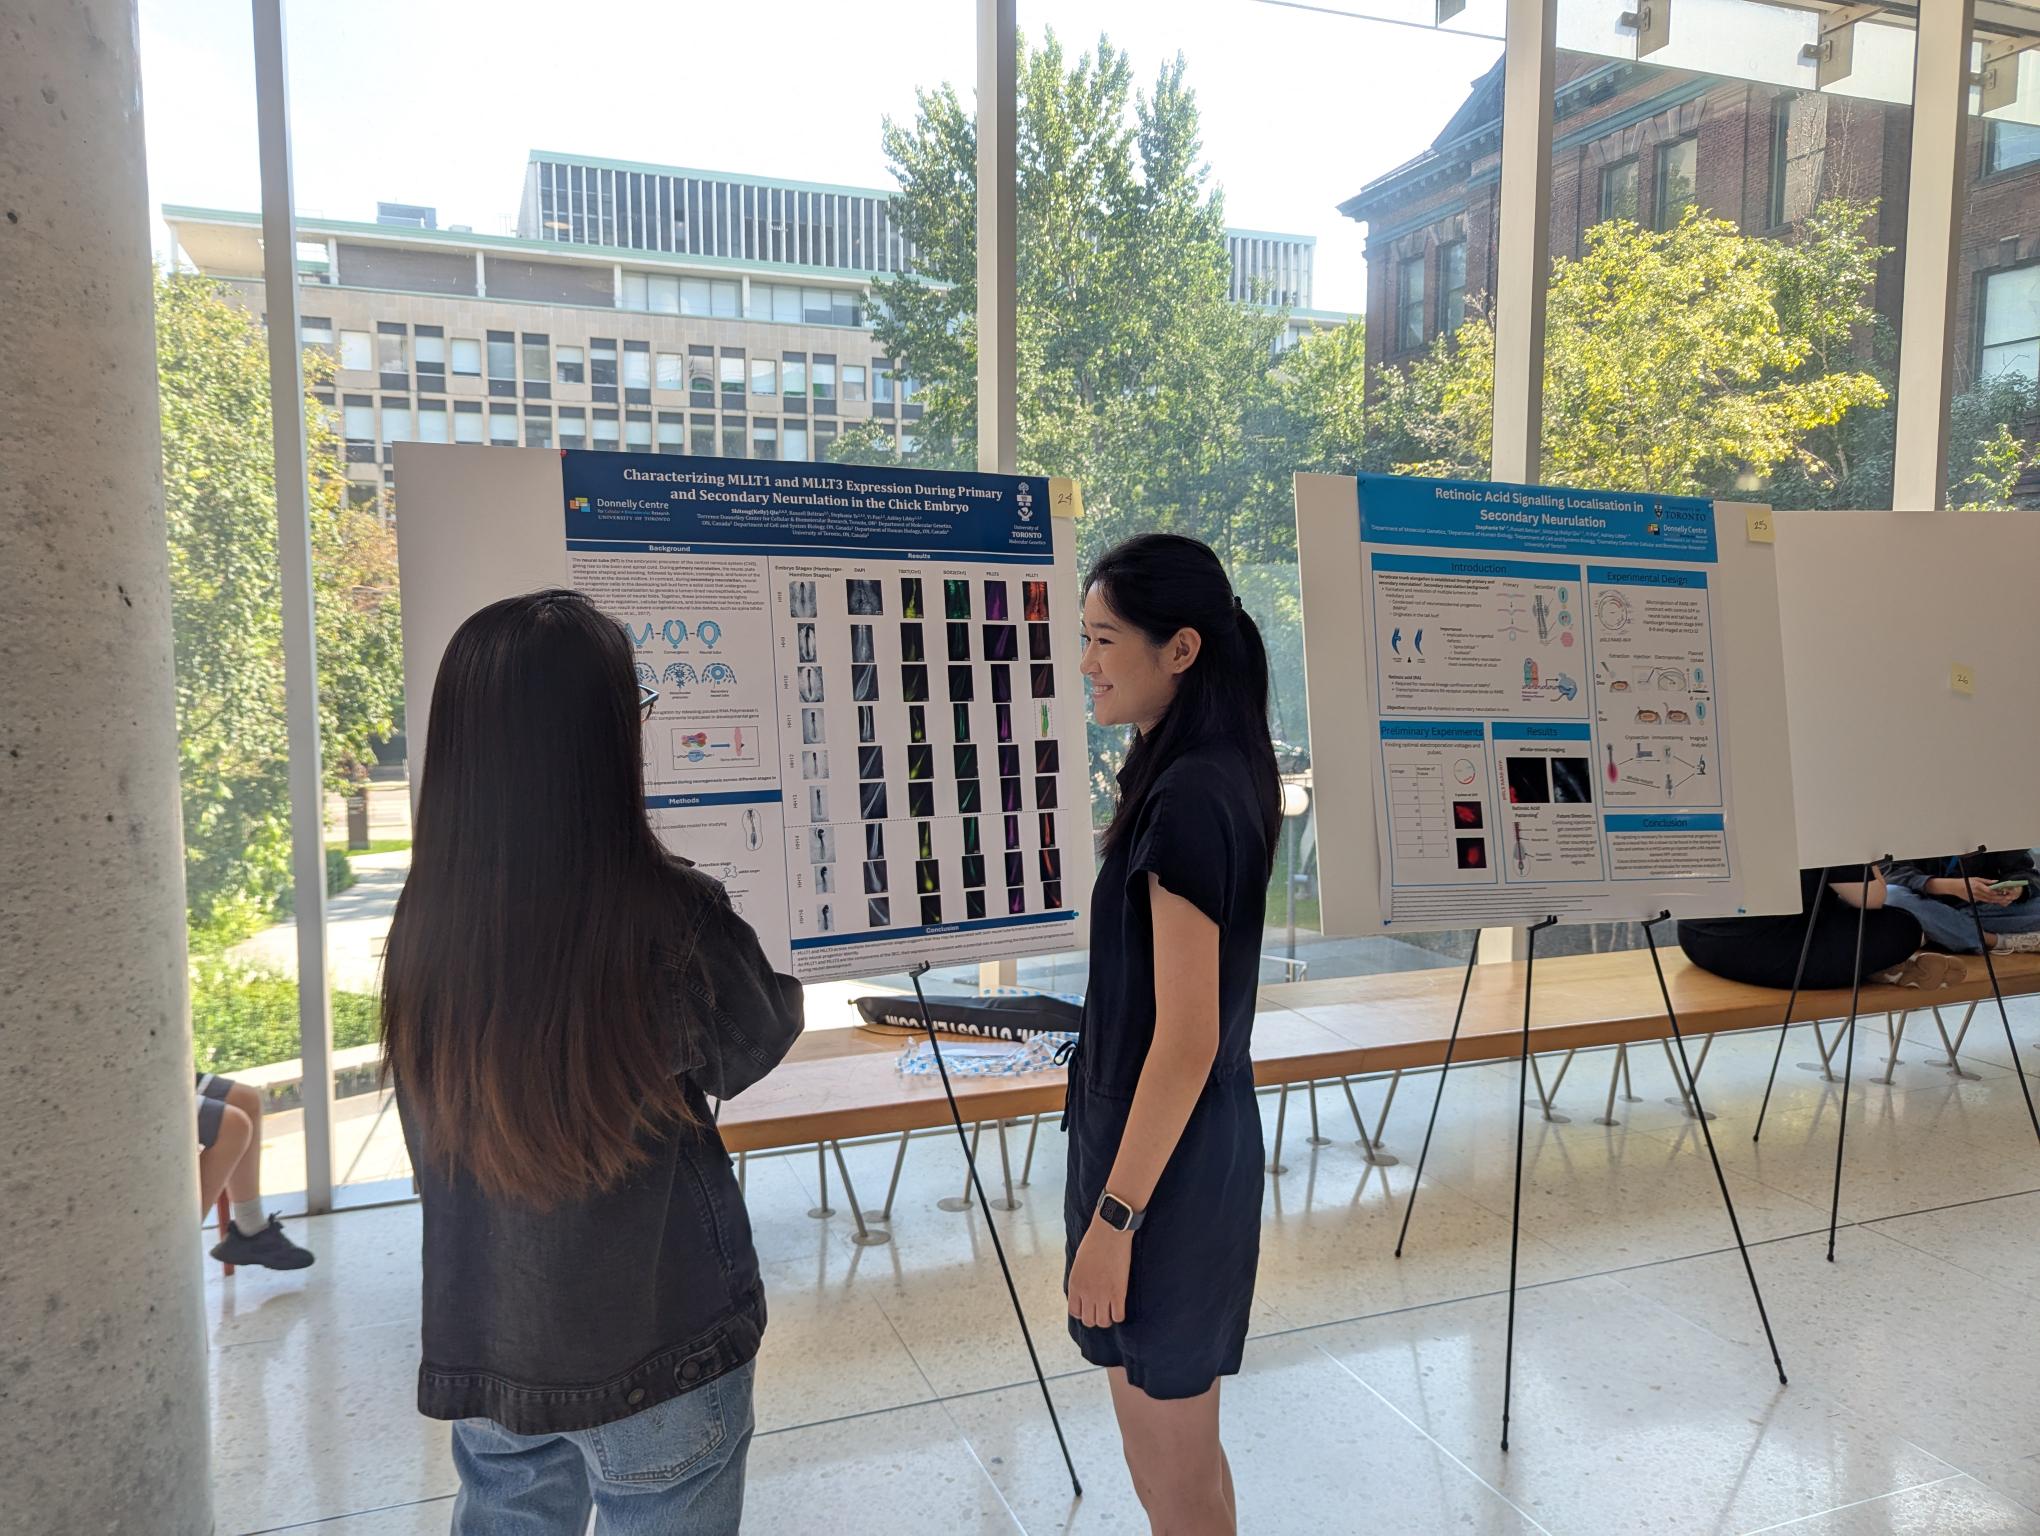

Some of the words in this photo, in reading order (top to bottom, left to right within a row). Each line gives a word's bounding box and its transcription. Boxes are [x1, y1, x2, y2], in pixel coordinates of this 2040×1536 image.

[623, 468, 726, 487] Characterizing
[728, 474, 771, 487] MLLT1
[774, 477, 799, 488] and
[802, 478, 843, 490] MLLT3
[846, 480, 912, 494] Expression
[915, 484, 955, 498] During
[958, 486, 1003, 501] Primary
[670, 489, 696, 500] and
[699, 489, 769, 505] Secondary
[773, 493, 848, 507] Neurulation
[851, 497, 863, 508] in
[866, 498, 886, 509] the
[888, 499, 922, 510] Chick
[924, 500, 969, 514] Embryo
[1057, 492, 1073, 505] 24
[1435, 487, 1482, 501] Retinoic
[1484, 490, 1510, 503] Acid
[1512, 493, 1565, 509] Signalling
[1567, 497, 1632, 512] Localisation
[1634, 500, 1644, 512] in
[597, 498, 637, 510] Donnelly
[638, 501, 670, 510] Centre
[1480, 509, 1539, 525] Secondary
[1541, 513, 1607, 528] Neurulation
[1665, 511, 1706, 521] TORONTO
[1663, 524, 1688, 534] Donnelly
[1688, 526, 1707, 534] Centre
[1012, 531, 1042, 539] TORONTO
[648, 544, 691, 553] Background
[907, 552, 931, 560] Results
[1451, 563, 1507, 573] Introduction
[1607, 572, 1660, 583] Experimental
[1661, 574, 1688, 585] Design
[1381, 726, 1430, 738] Preliminary
[1431, 727, 1483, 738] Experiments
[1527, 727, 1558, 736] Results
[668, 797, 700, 805] Methods
[1643, 818, 1688, 828] Conclusion
[926, 925, 960, 935] Conclusion
